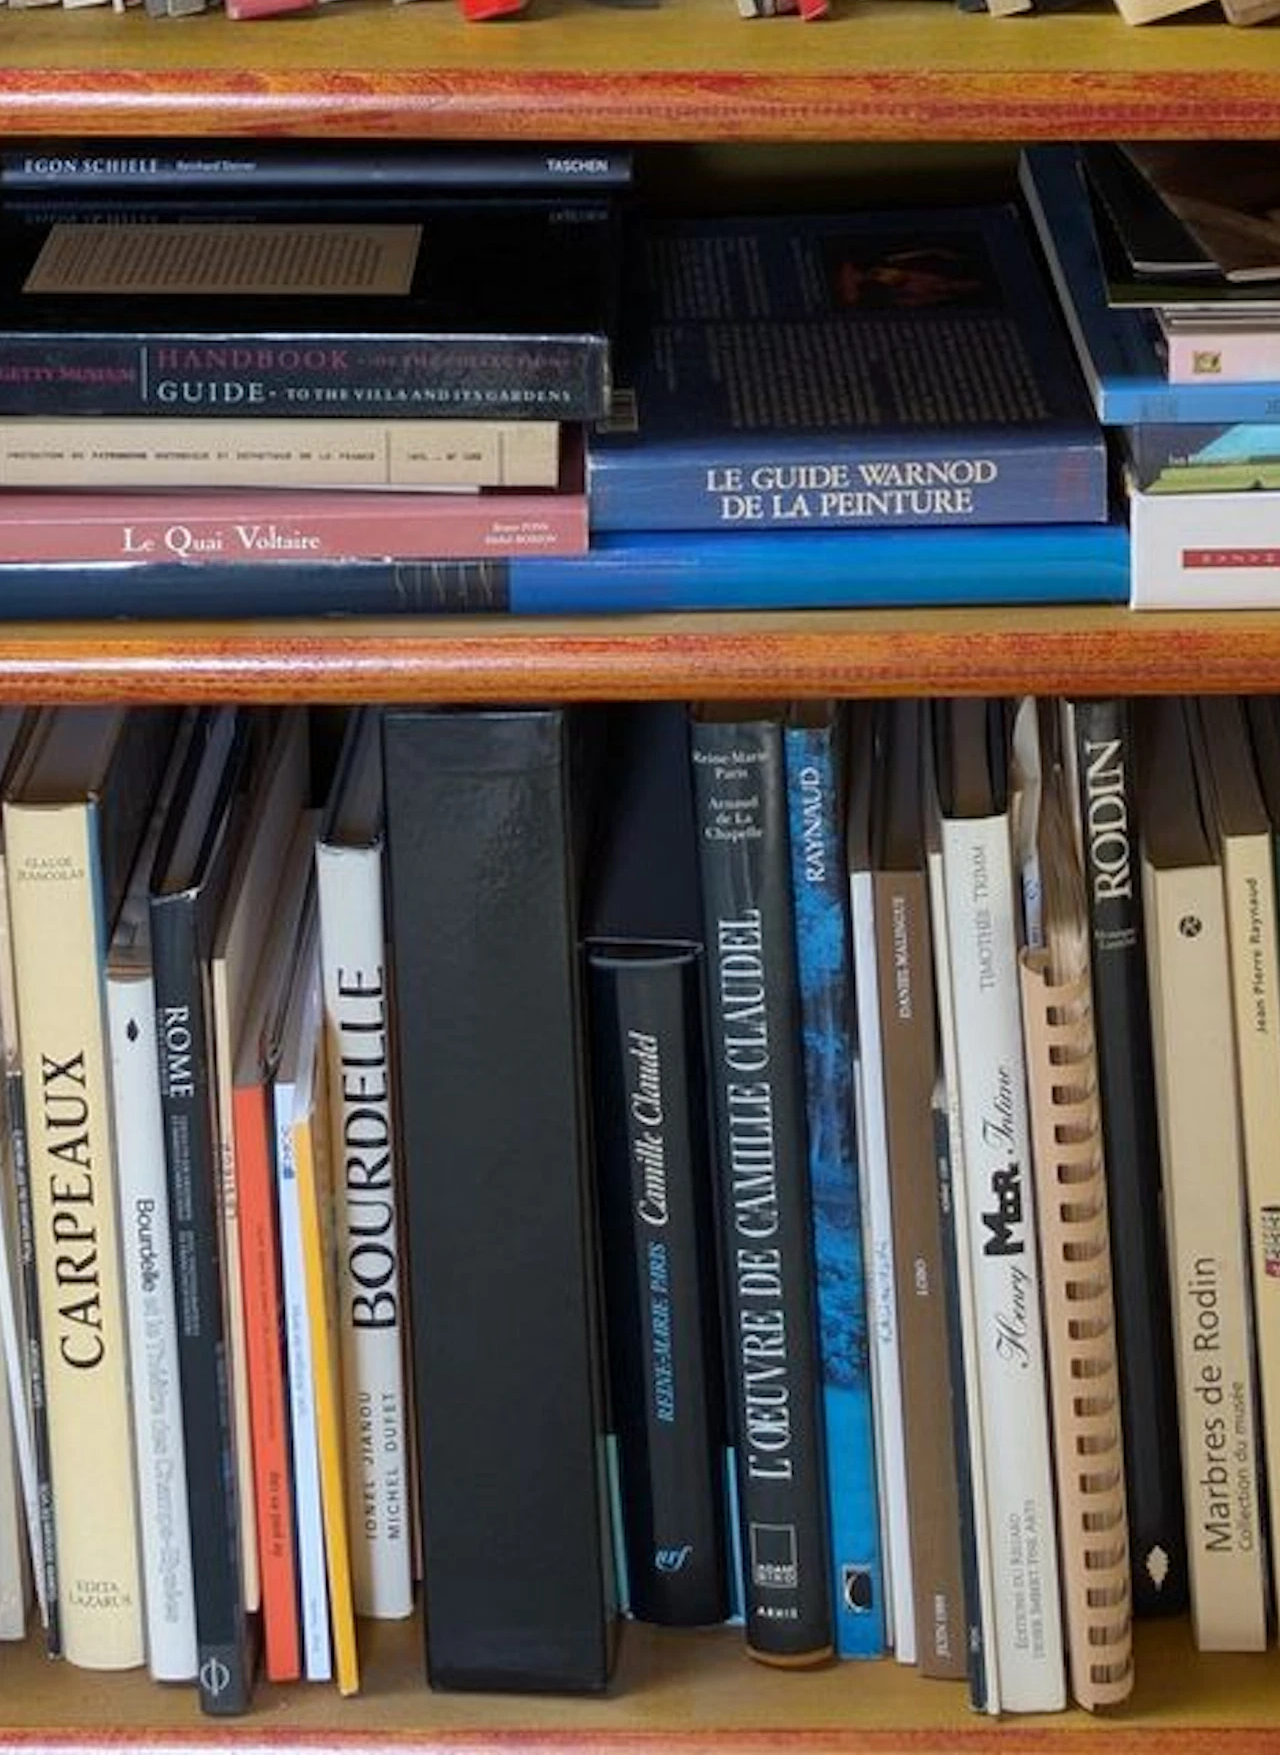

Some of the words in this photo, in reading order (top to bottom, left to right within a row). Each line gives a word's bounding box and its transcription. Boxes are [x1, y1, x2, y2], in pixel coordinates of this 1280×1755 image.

[157, 346, 351, 372] HANDBOOK
[705, 467, 752, 494] LE
[755, 464, 850, 492] GUIDE
[857, 459, 999, 490] WARNOD
[721, 494, 766, 521] DE
[771, 492, 812, 519] LA
[819, 488, 974, 517] PEINTURE
[122, 526, 157, 554] Le
[163, 523, 224, 558] Quai
[236, 523, 322, 553] Voltaire
[799, 767, 826, 883] RAYNAUD
[1083, 738, 1133, 904] RODIN
[1247, 877, 1262, 942] Raynaud
[718, 908, 770, 1073] CLAUDEL
[161, 1004, 195, 1099] ROME
[336, 966, 398, 1331] BOURDELLE
[635, 1130, 669, 1227] Camille
[726, 1081, 780, 1239] CAMILLE
[41, 1048, 106, 1369] CARPEAUX
[1188, 1255, 1223, 1358] Rodin
[384, 1389, 398, 1457] DUFET
[386, 1463, 401, 1540] MICHEL
[1199, 1414, 1234, 1555] Marbres
